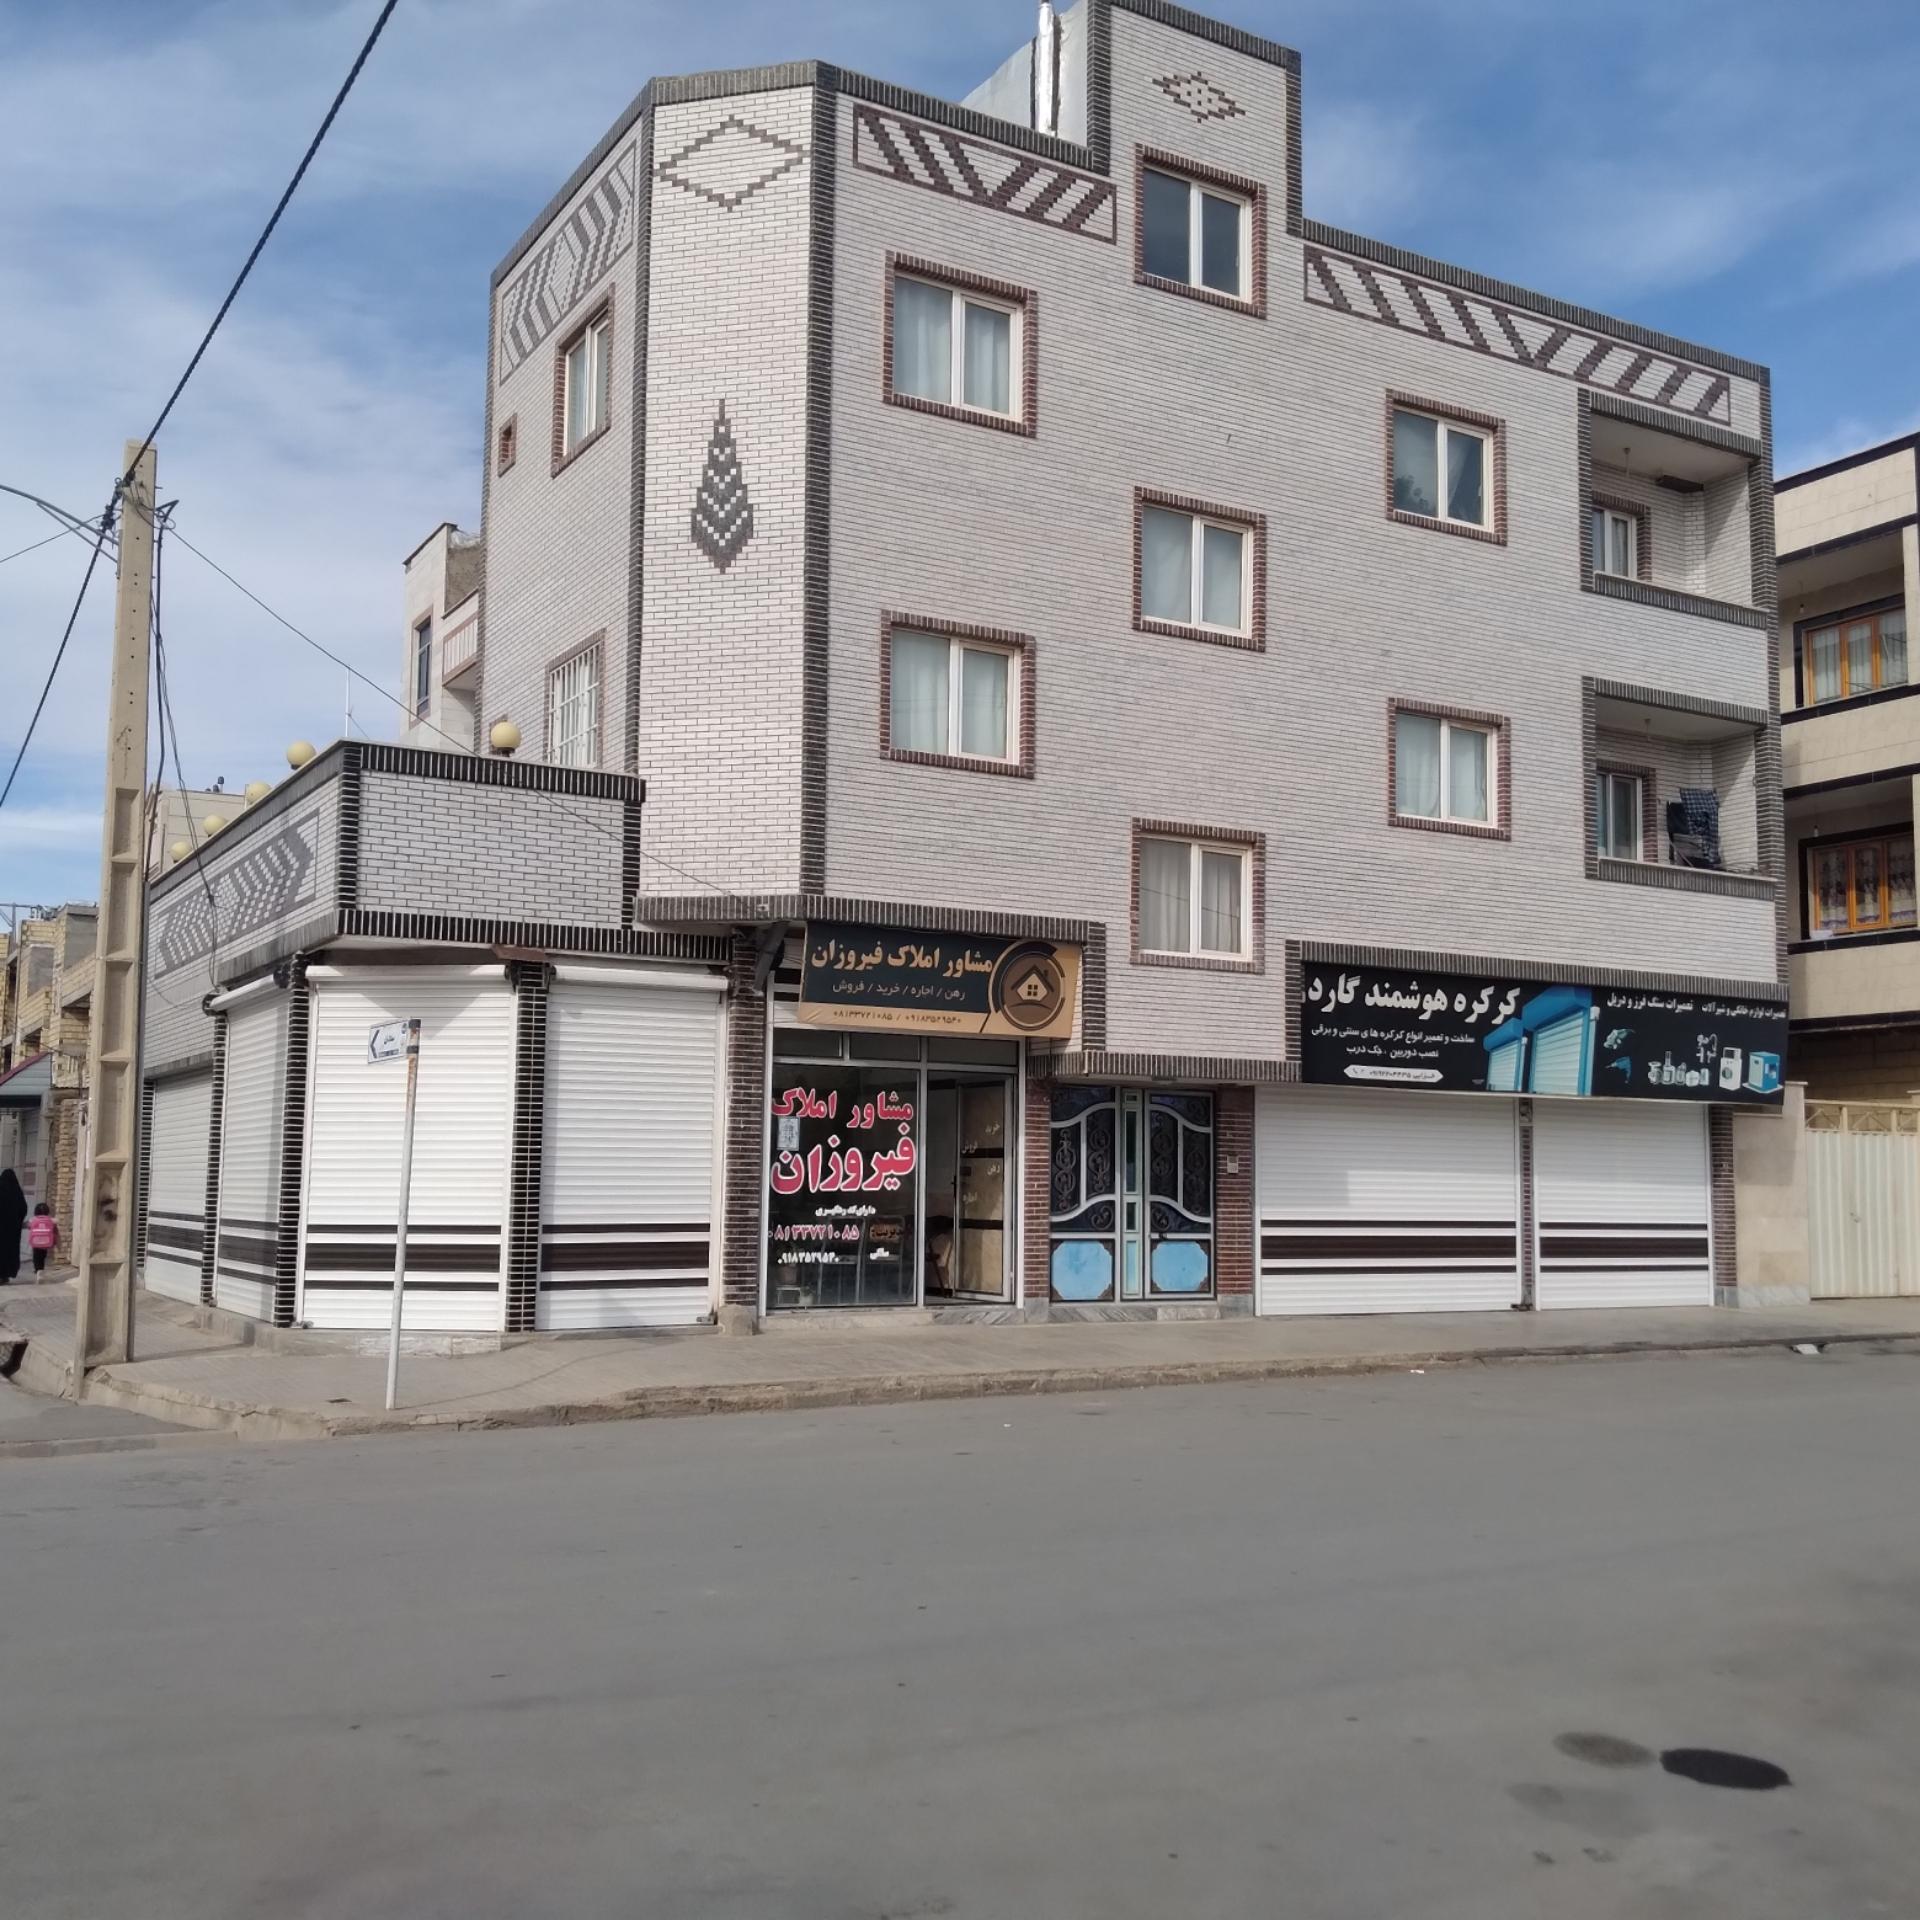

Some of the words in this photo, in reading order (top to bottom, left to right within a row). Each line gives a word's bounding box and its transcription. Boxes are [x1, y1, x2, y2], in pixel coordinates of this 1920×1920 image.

[811, 939, 884, 971] فیروزان
[887, 943, 940, 969] املاک
[943, 949, 993, 978] مشاور
[832, 979, 865, 994] فروش
[876, 983, 900, 996] خرید
[910, 985, 934, 999] اجاره
[1307, 972, 1361, 1013] گارد
[945, 988, 966, 1001] رهن
[1364, 980, 1449, 1020] هوشمند
[1607, 992, 1626, 1007] دریل
[1453, 985, 1521, 1025] کرکره
[1311, 1024, 1332, 1036] برقی
[1332, 1027, 1338, 1037] و
[1338, 1027, 1360, 1038] سنتی
[1405, 1030, 1422, 1044] انواع
[1423, 1032, 1444, 1044] تعمیر
[1444, 1035, 1450, 1044] و
[1450, 1032, 1476, 1043] ساخت
[1346, 1044, 1366, 1055] درب
[1418, 1048, 1440, 1058] نصب
[771, 1087, 837, 1119] املاک
[846, 1090, 914, 1128] مشاور
[771, 1122, 916, 1194] فیروزان
